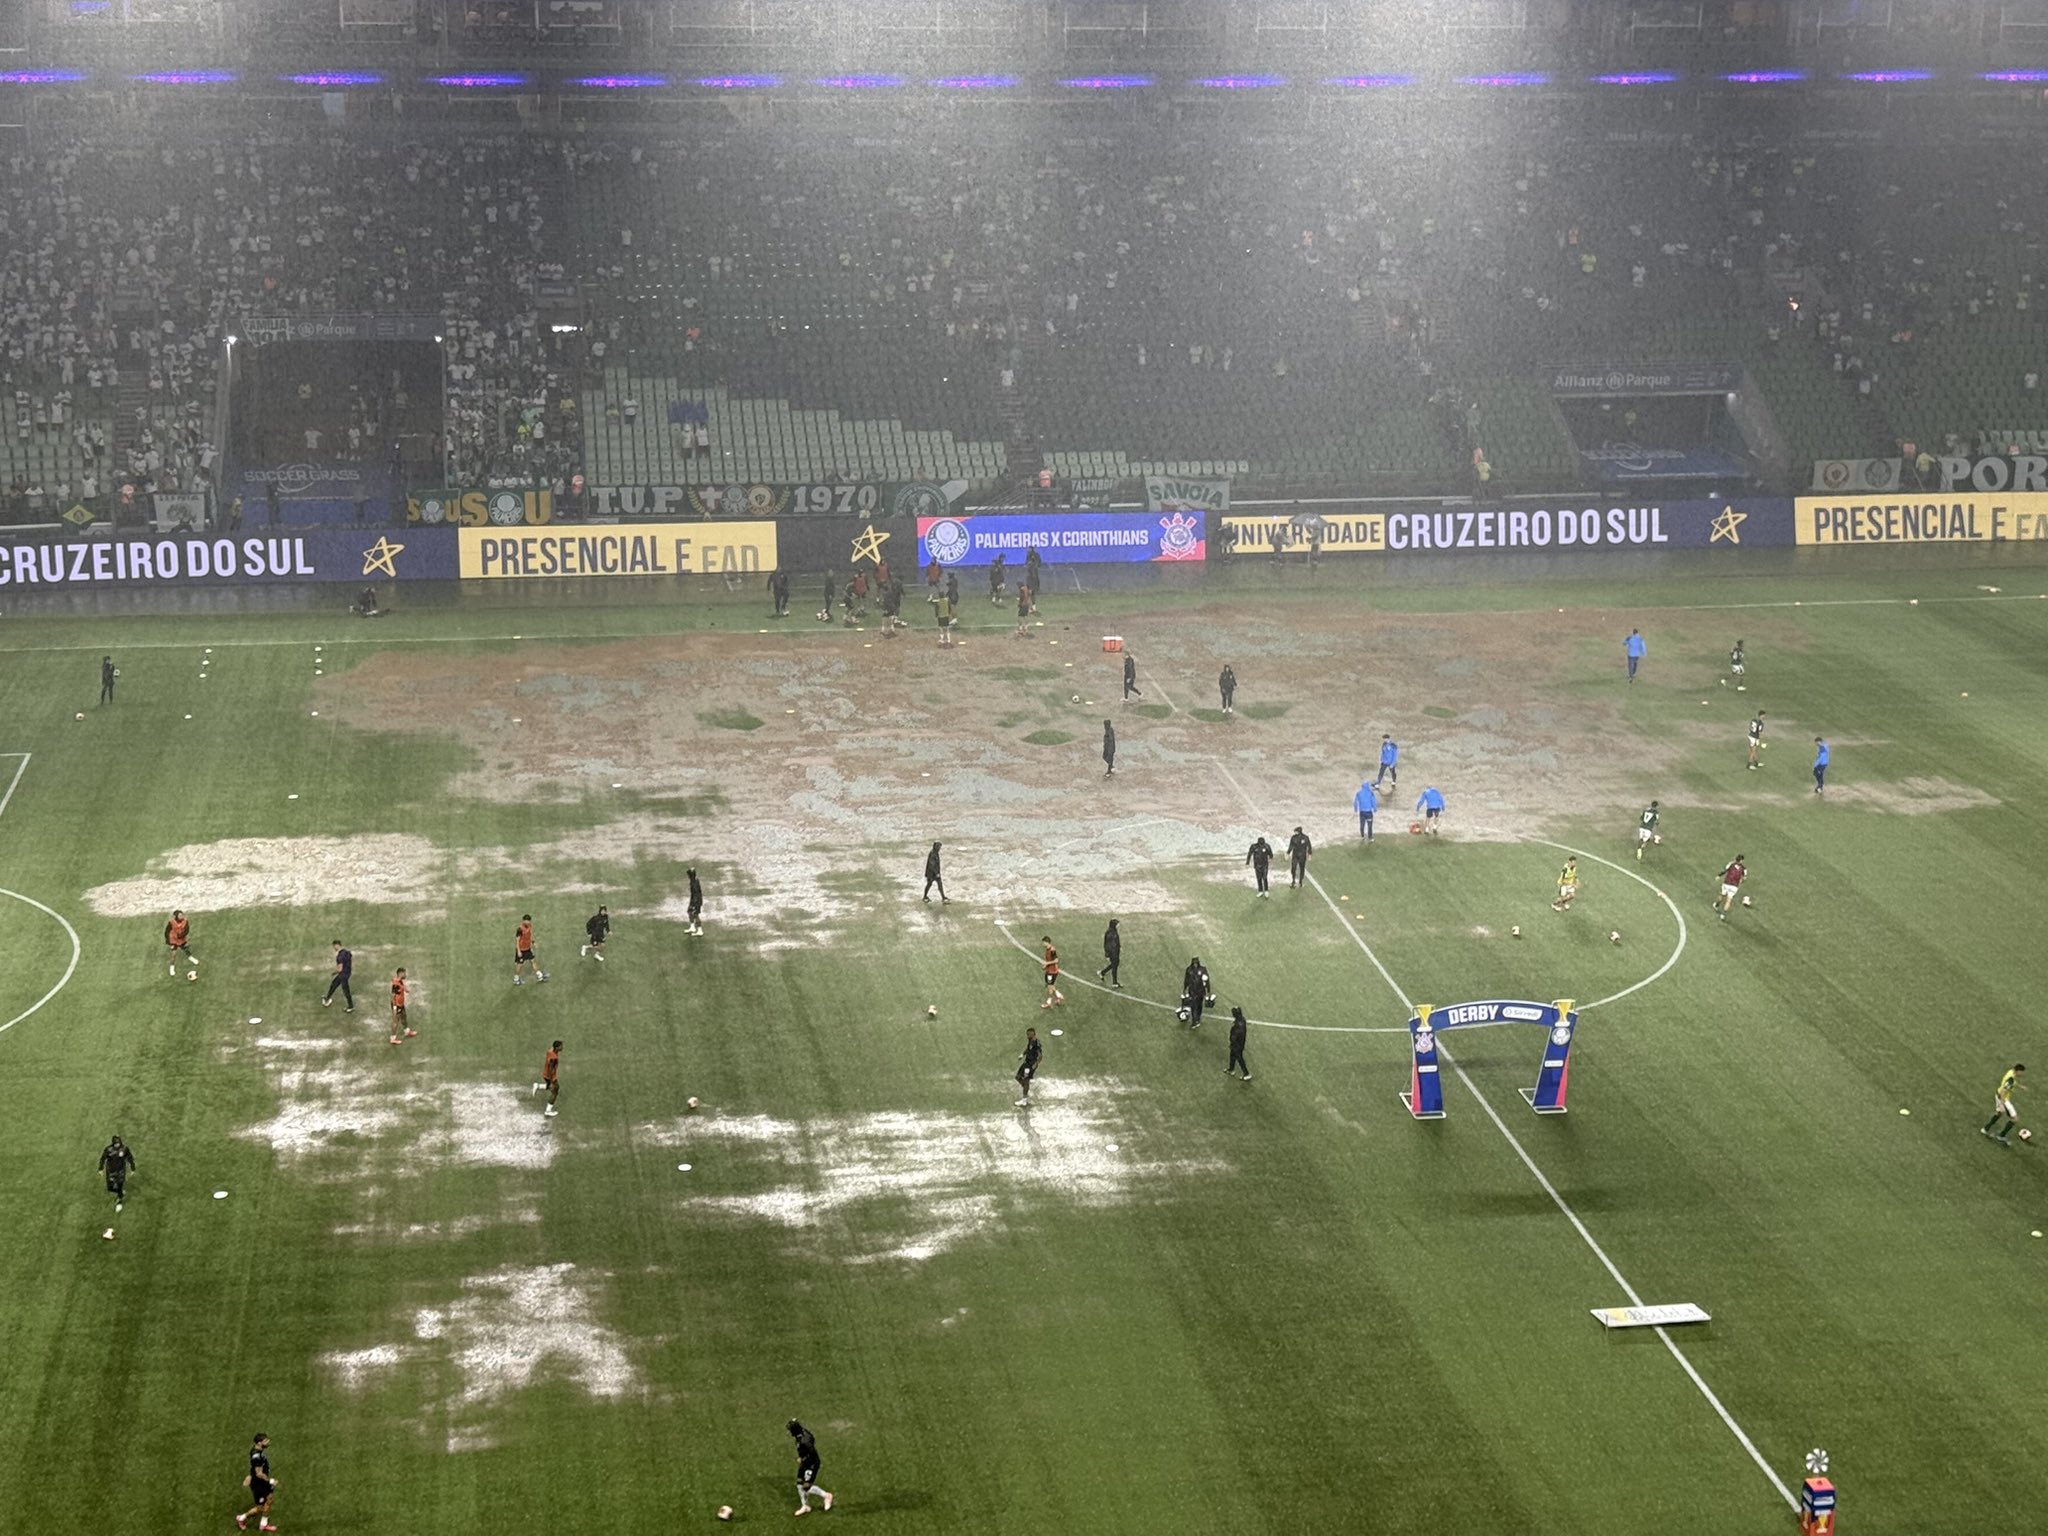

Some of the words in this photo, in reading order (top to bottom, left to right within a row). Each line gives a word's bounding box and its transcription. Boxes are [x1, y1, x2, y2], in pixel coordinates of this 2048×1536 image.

[316, 323, 356, 337] Parque
[1555, 374, 1603, 387] Allianz
[1626, 373, 1671, 388] Parque
[244, 470, 307, 481] SOCCER
[309, 470, 360, 481] GRASS
[590, 487, 683, 514] T.U.P.
[794, 485, 877, 513] 1970
[1149, 482, 1224, 509] SAVOIA
[1388, 510, 1551, 549] CRUZEIRO
[1558, 509, 1600, 544] DO
[1606, 508, 1668, 544] SUL
[1814, 504, 1982, 542] PRESENCIAL
[1991, 507, 2007, 541] E
[975, 532, 1048, 548] PALMEIRAS
[1051, 532, 1060, 547] X
[1062, 530, 1149, 546] CORINTHIANS
[187, 539, 237, 577] DO
[243, 538, 315, 576] SUL
[481, 535, 667, 576] PRESENCIAL
[675, 538, 692, 575] E
[1448, 1004, 1499, 1025] DERBY
